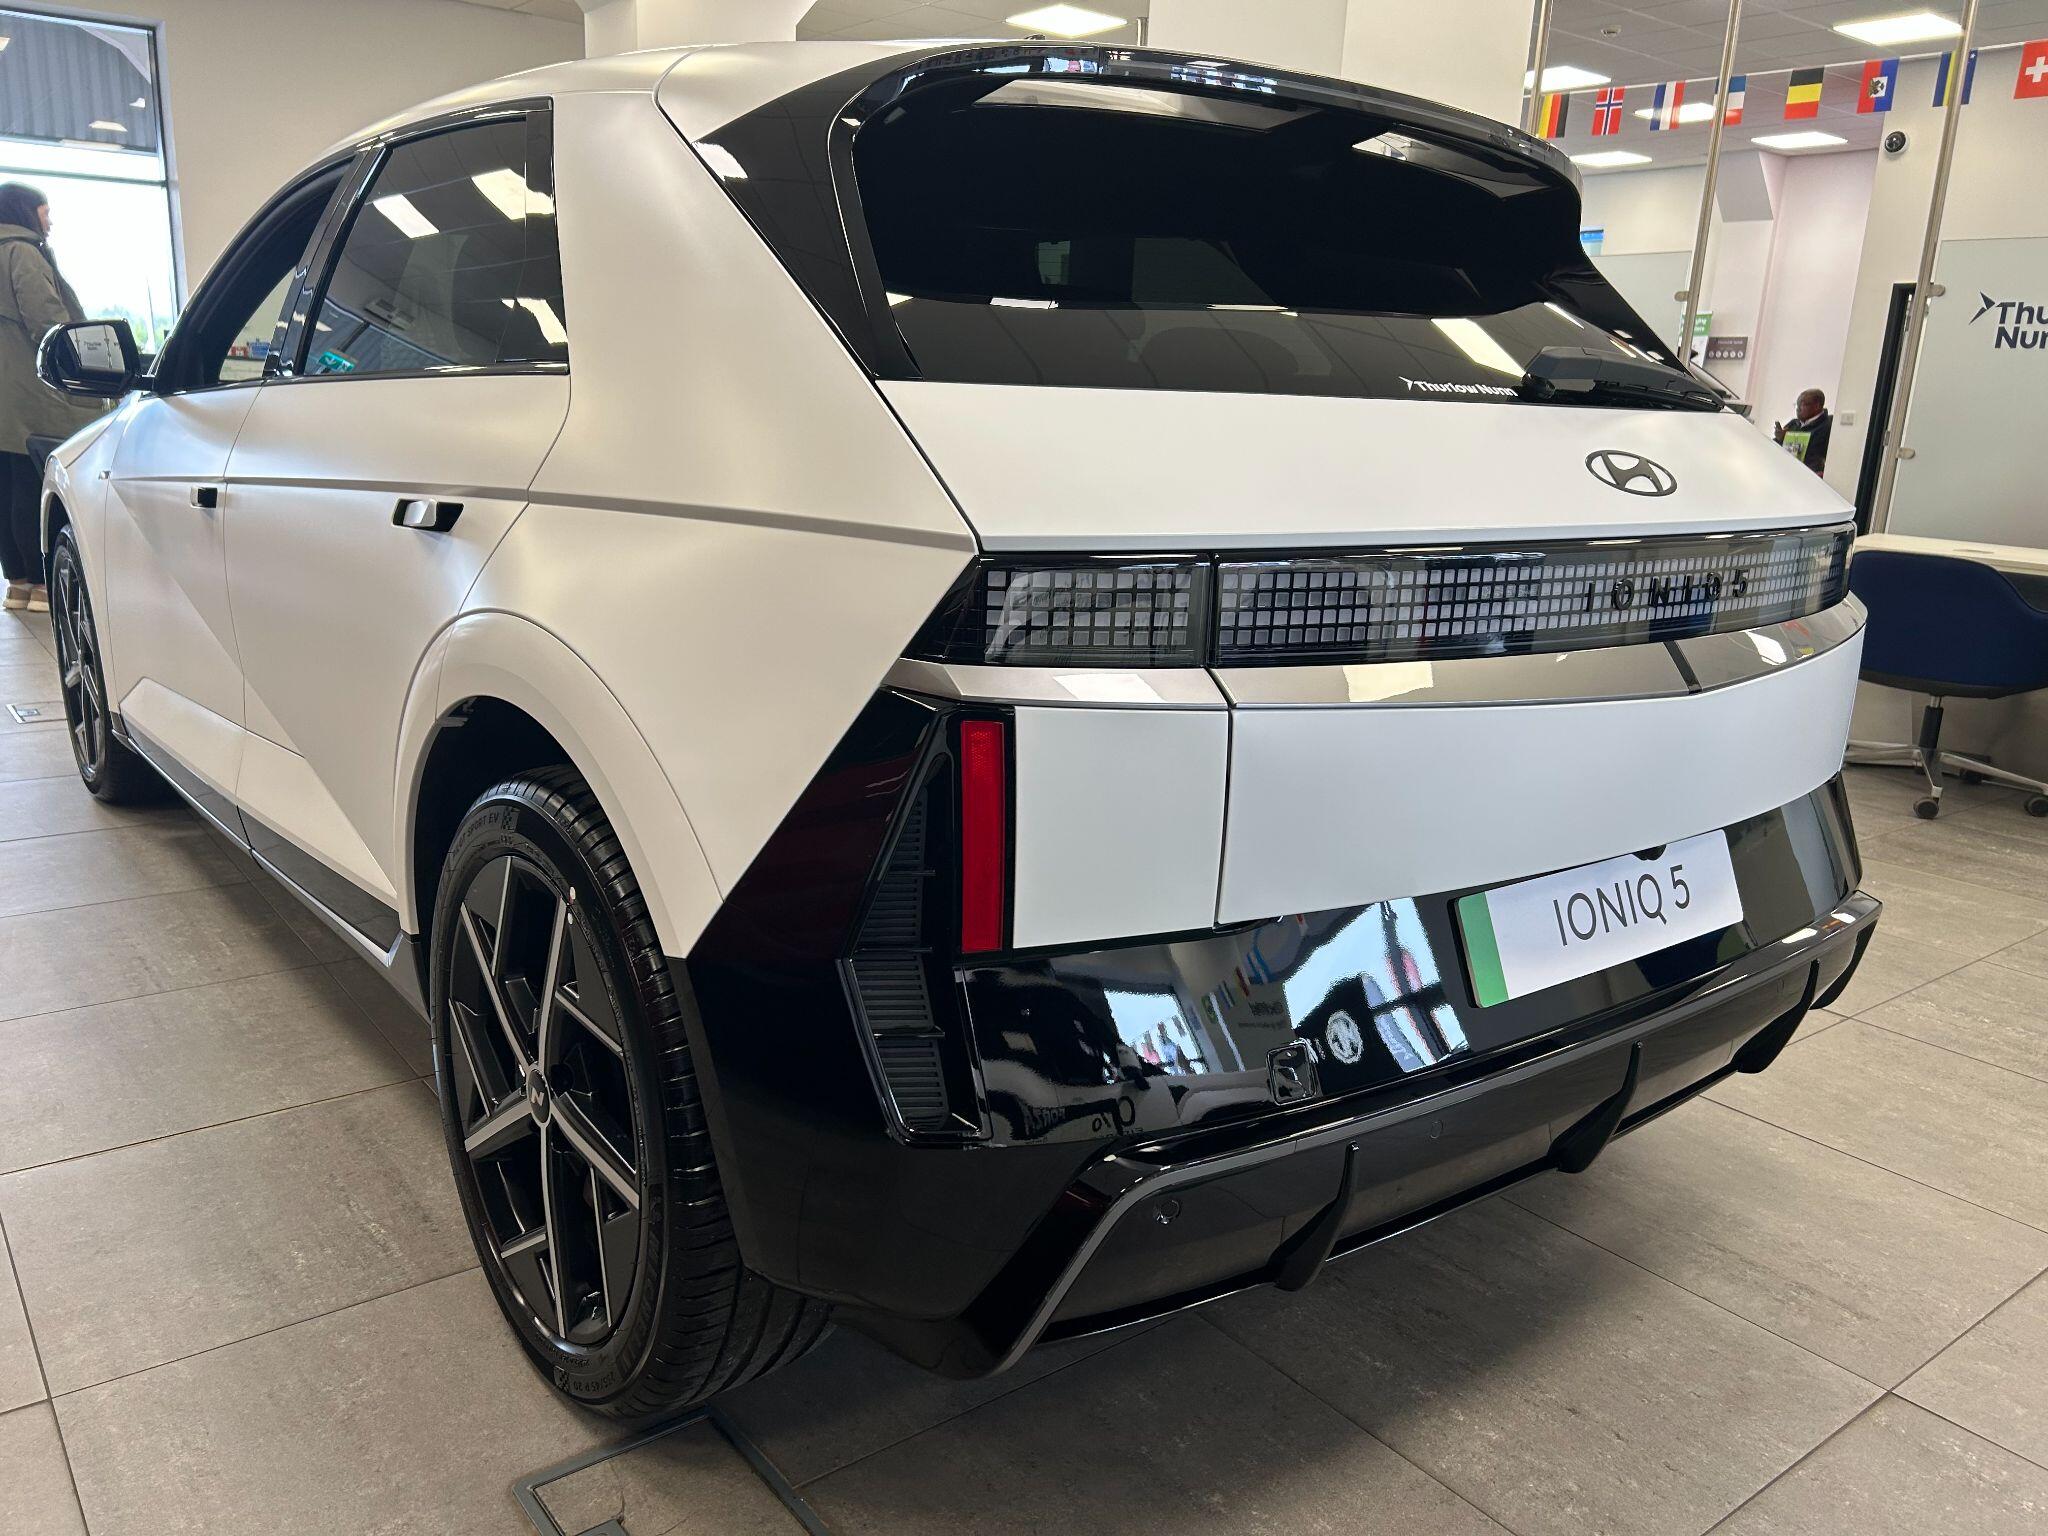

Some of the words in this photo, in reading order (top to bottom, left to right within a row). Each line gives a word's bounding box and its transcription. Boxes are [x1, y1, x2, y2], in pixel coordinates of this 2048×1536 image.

[1413, 380, 1479, 395] Thurlow
[1477, 384, 1519, 397] Nunn
[1732, 568, 1749, 598] 5
[467, 815, 487, 837] SPORT
[488, 812, 499, 825] EV
[1552, 872, 1668, 947] IONIQ
[1669, 864, 1691, 910] 5
